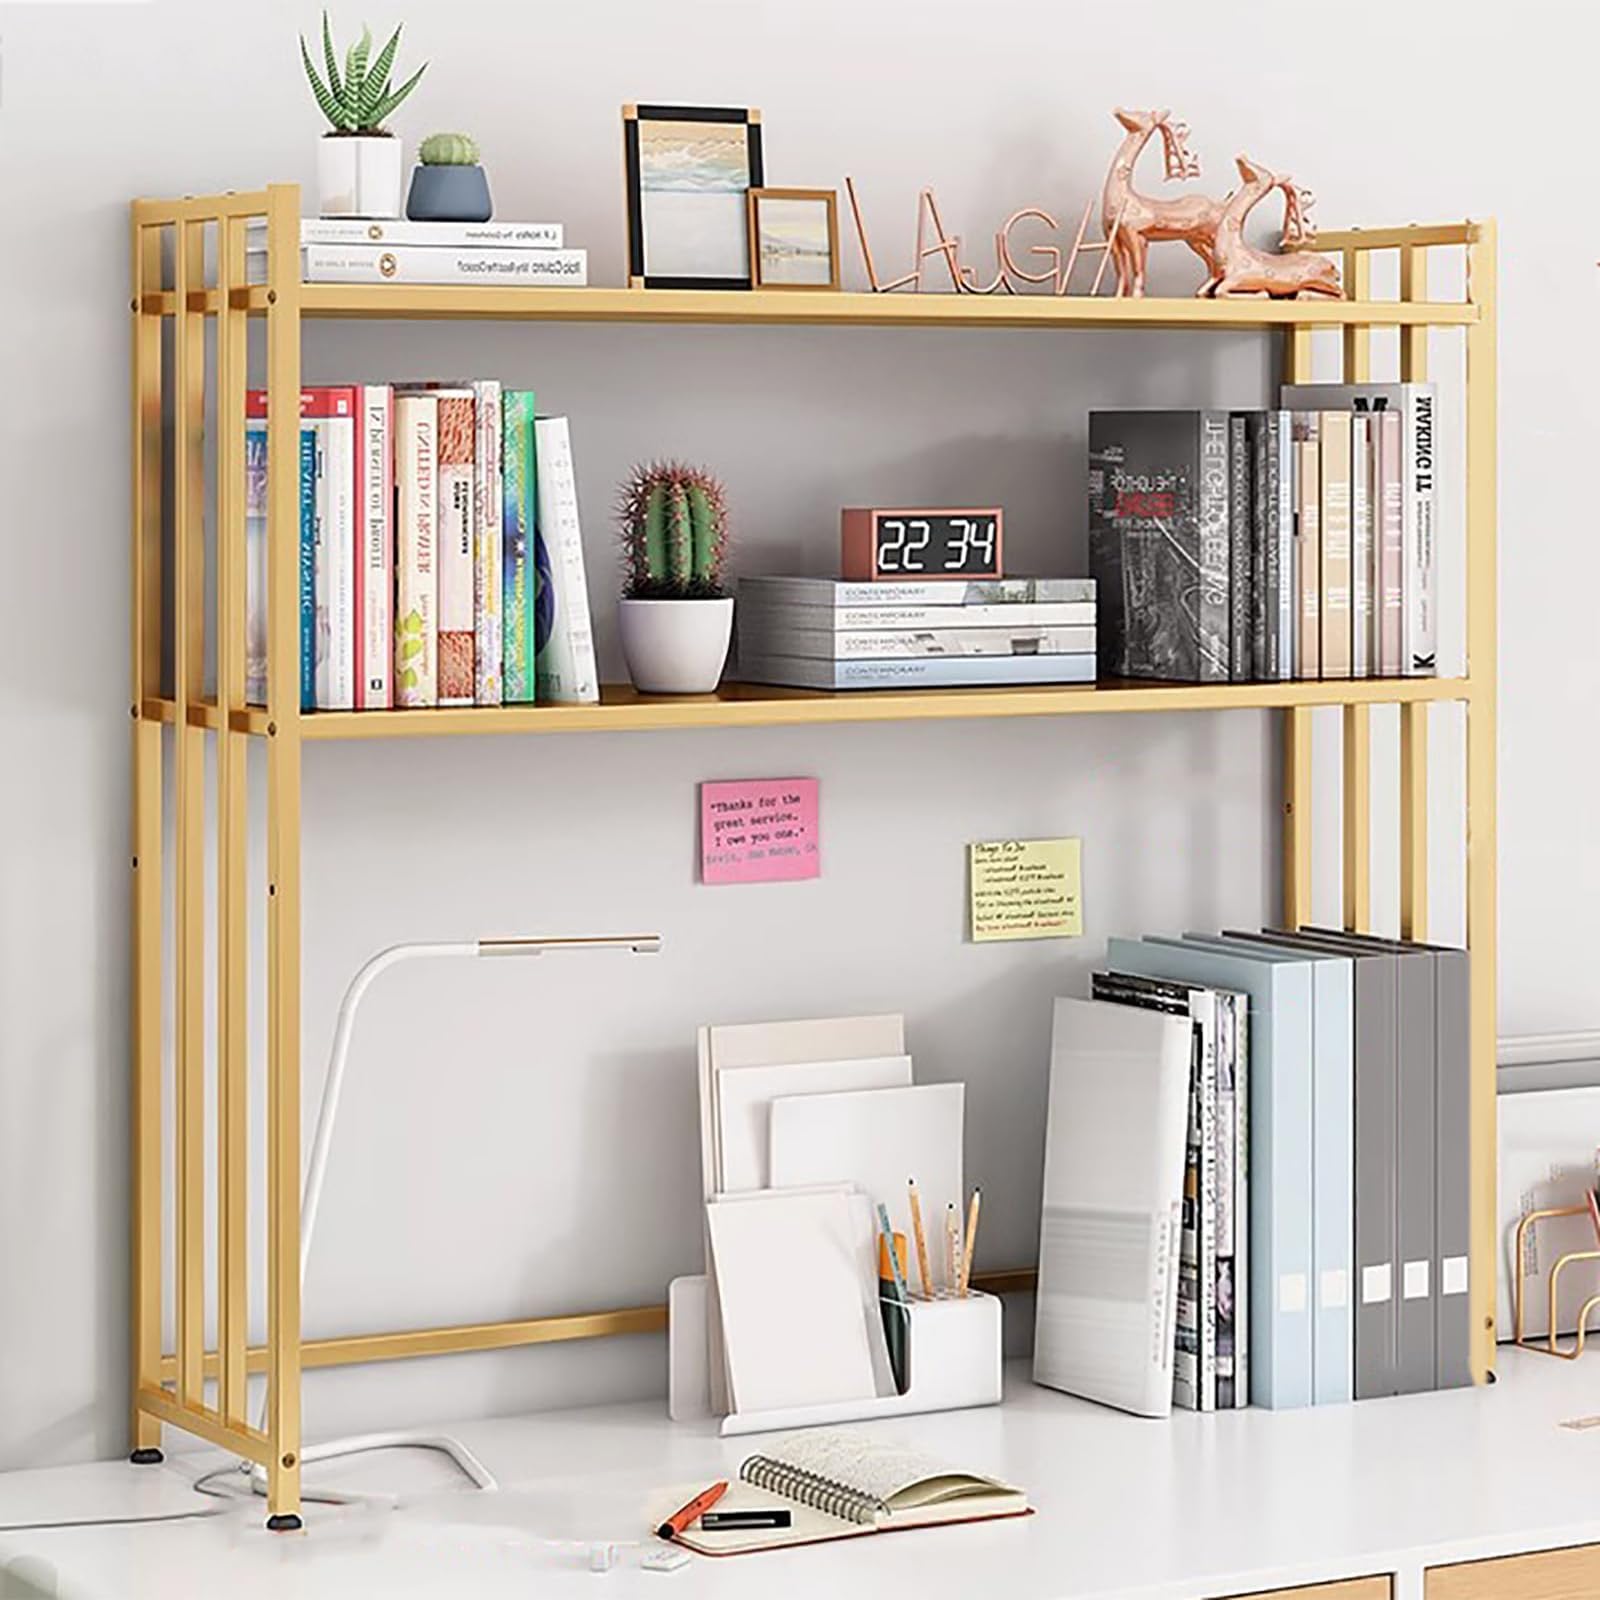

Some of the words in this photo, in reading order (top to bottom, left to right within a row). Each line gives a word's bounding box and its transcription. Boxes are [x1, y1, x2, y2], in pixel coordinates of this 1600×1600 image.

[878, 520, 930, 570] 22
[944, 519, 995, 569] 34
[759, 797, 777, 808] for
[782, 793, 801, 805] the
[714, 817, 745, 832] great
[751, 833, 770, 845] you
